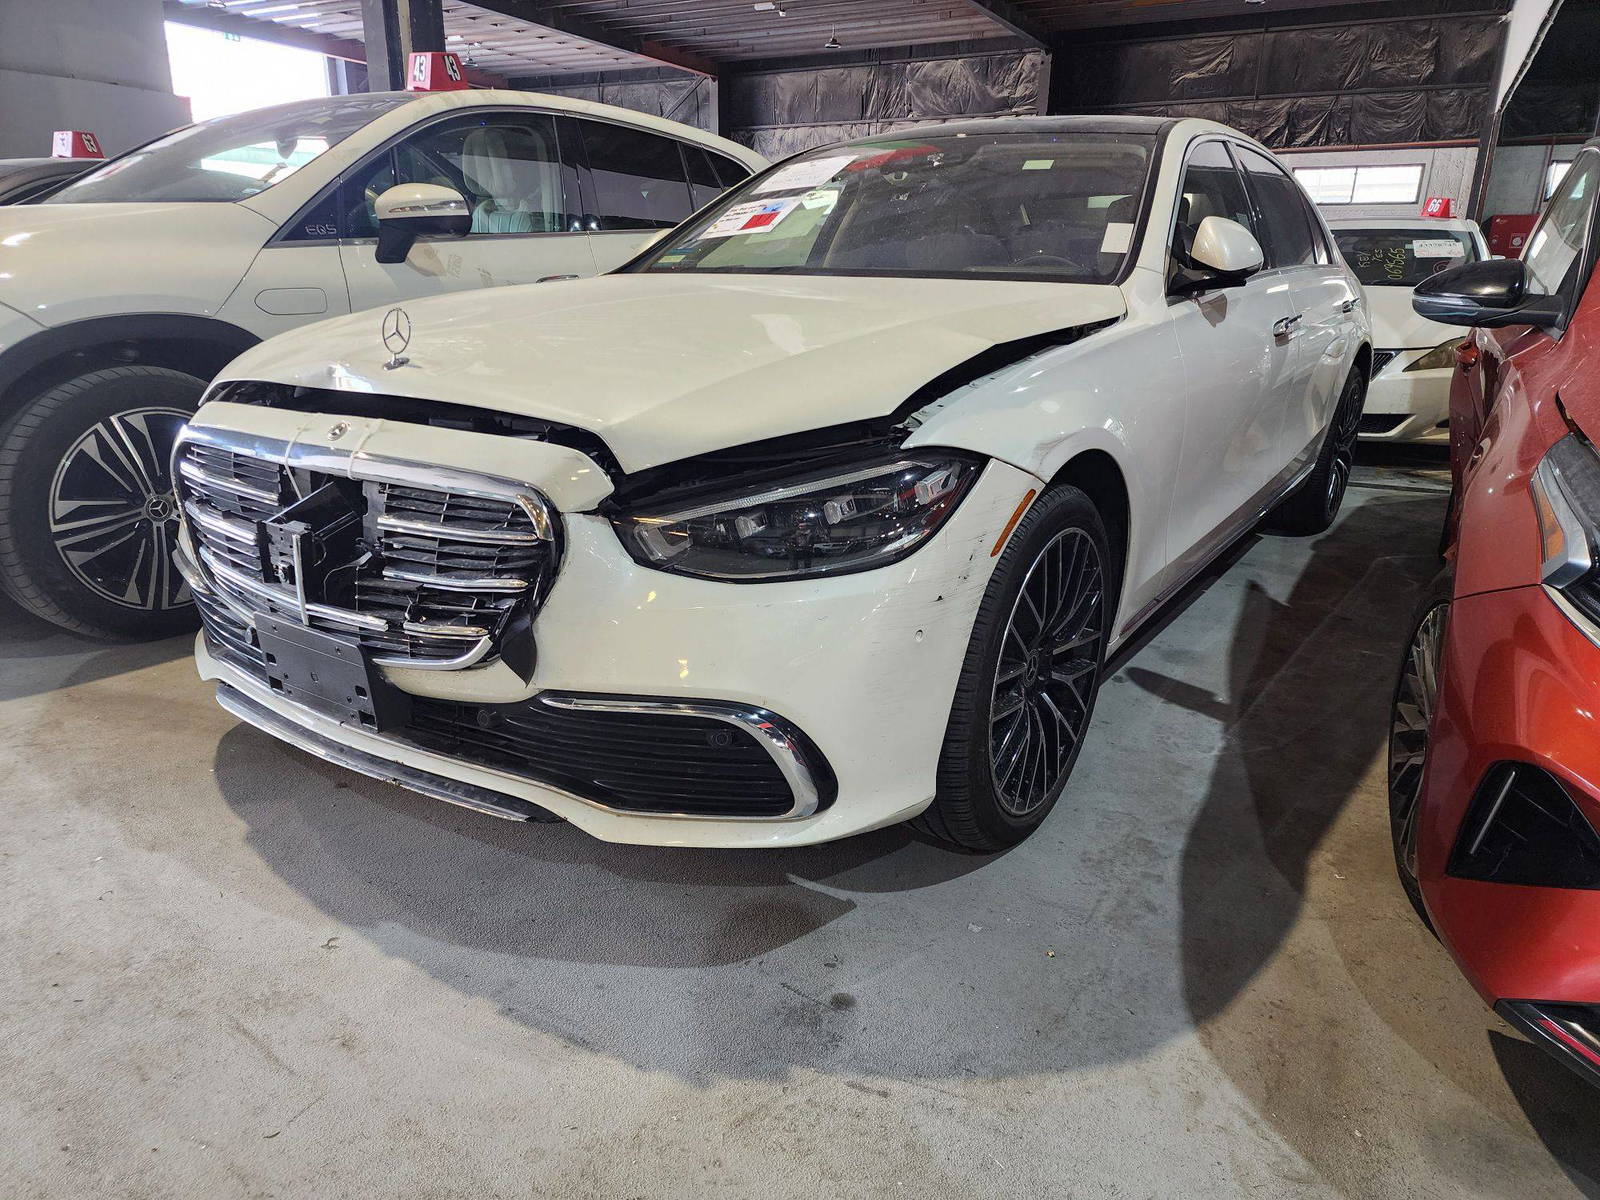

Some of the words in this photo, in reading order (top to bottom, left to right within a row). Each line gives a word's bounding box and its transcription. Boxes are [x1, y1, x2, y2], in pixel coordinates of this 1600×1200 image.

[414, 55, 427, 82] 43
[443, 55, 462, 81] 43
[1427, 199, 1442, 212] 66
[304, 223, 337, 235] EQS
